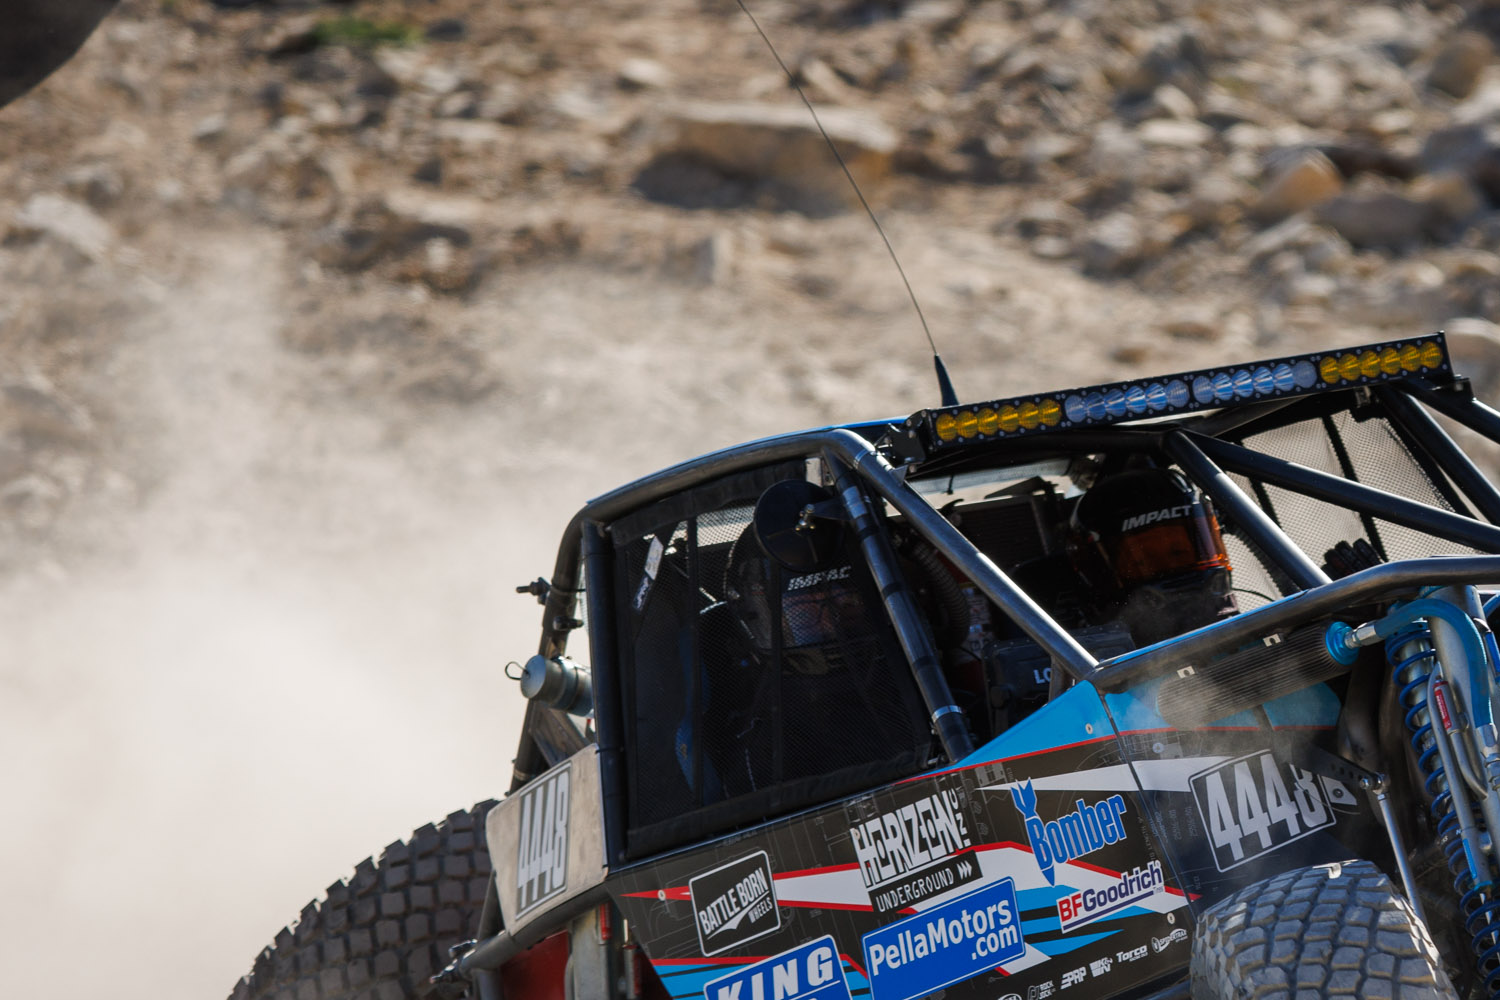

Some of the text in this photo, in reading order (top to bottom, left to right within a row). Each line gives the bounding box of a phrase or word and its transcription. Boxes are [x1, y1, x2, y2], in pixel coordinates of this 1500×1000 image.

[1122, 505, 1192, 532] IMPACT
[518, 771, 570, 909] 4448
[1025, 793, 1128, 872] Bomber
[699, 867, 769, 936] BATTLE BORN
[748, 897, 773, 924] WHEELS
[875, 867, 954, 913] UNDERGROUND
[1058, 862, 1163, 923] BFGoodrich
[869, 899, 1013, 977] PellaMotors
[971, 924, 1019, 960] .com
[1116, 945, 1148, 963] Torco
